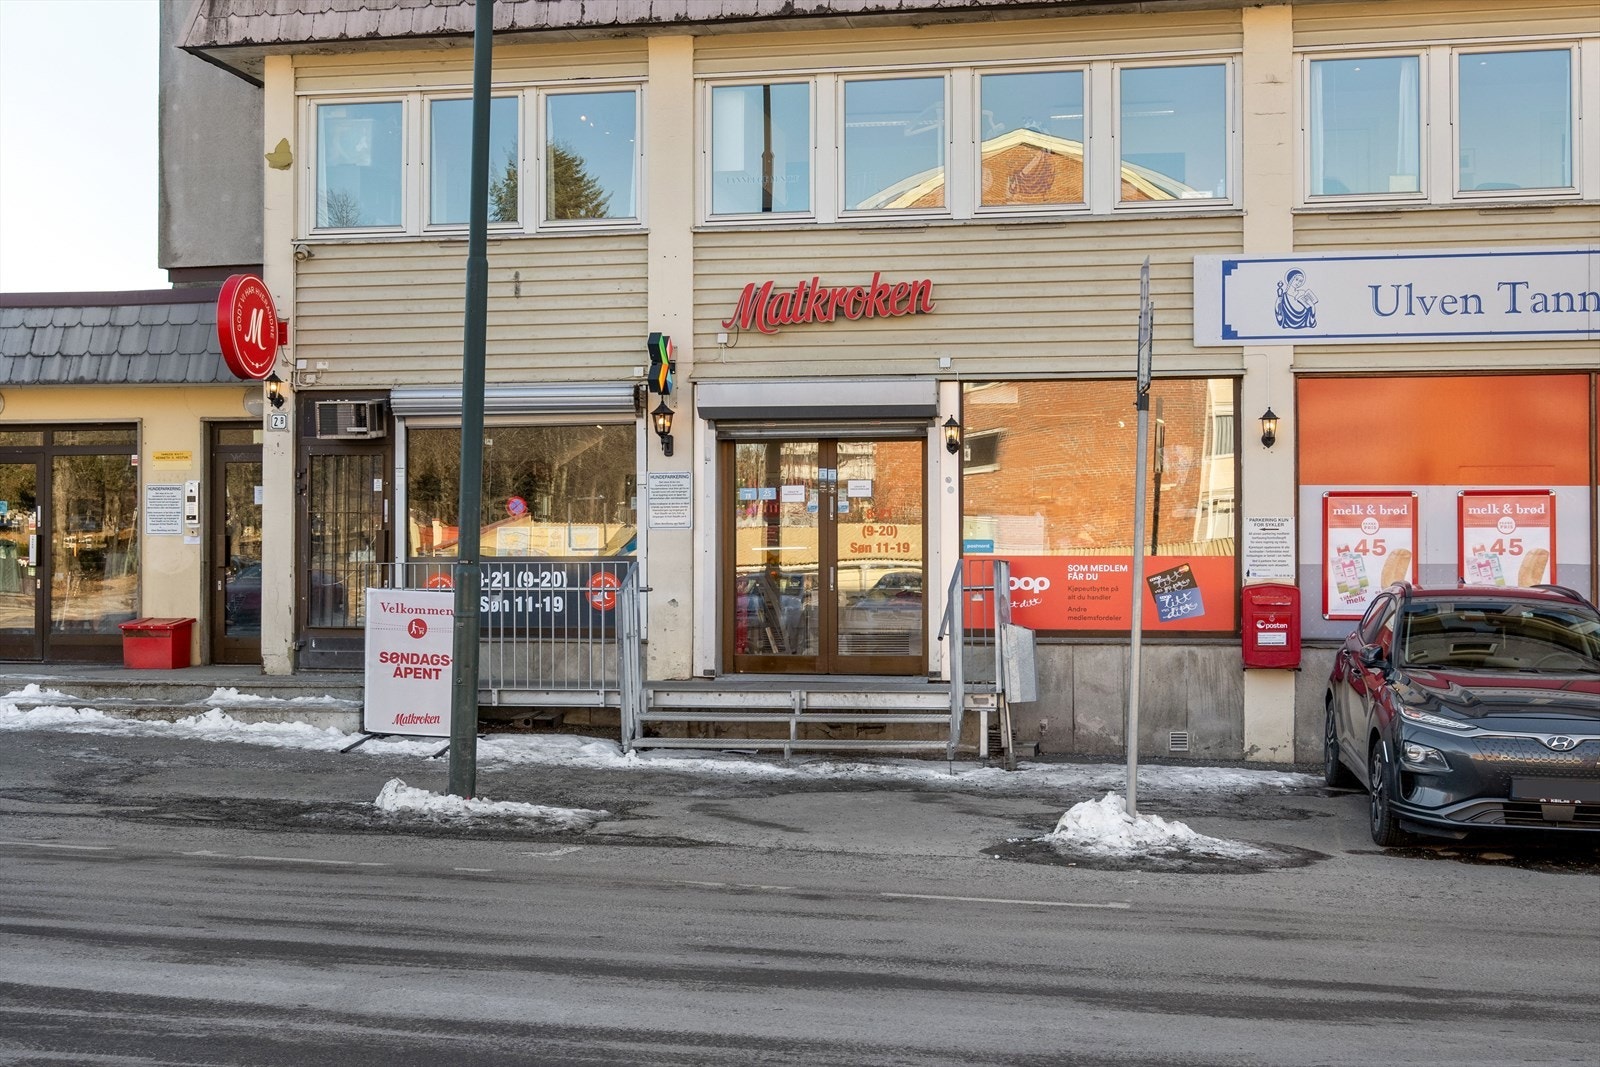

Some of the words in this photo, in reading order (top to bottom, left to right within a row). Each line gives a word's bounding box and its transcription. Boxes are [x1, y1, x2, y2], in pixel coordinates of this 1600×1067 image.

[721, 271, 937, 335] Matkroken
[1368, 281, 1485, 318] Ulven
[1497, 279, 1600, 316] Tann
[1333, 504, 1364, 516] melk
[1366, 505, 1376, 516] &
[1380, 504, 1408, 515] brød
[1468, 504, 1500, 514] melk
[1502, 504, 1513, 514] &
[1516, 504, 1546, 514] brød
[862, 525, 898, 539] (9-20)
[850, 542, 873, 554] Søn
[877, 542, 910, 554] 11-19
[1354, 538, 1386, 556] 45
[1490, 538, 1524, 556] 45
[1068, 564, 1088, 572] SOM
[1090, 564, 1128, 572] MEDLEM
[517, 571, 568, 588] (9-20)
[1068, 572, 1084, 581] FÅR
[1086, 573, 1098, 581] DU
[1010, 576, 1051, 594] oop
[1068, 586, 1109, 594] Kjøpeutbytte
[1110, 586, 1119, 594] på
[380, 602, 454, 616] Velkommen
[480, 596, 510, 612] Søn
[516, 596, 564, 612] 11-19
[1068, 614, 1122, 622] medlemsfordeler
[1266, 622, 1288, 630] posten
[379, 652, 453, 667] SØNDAGS-
[392, 664, 442, 680] ÅPENT
[392, 712, 440, 728] Matkroken
